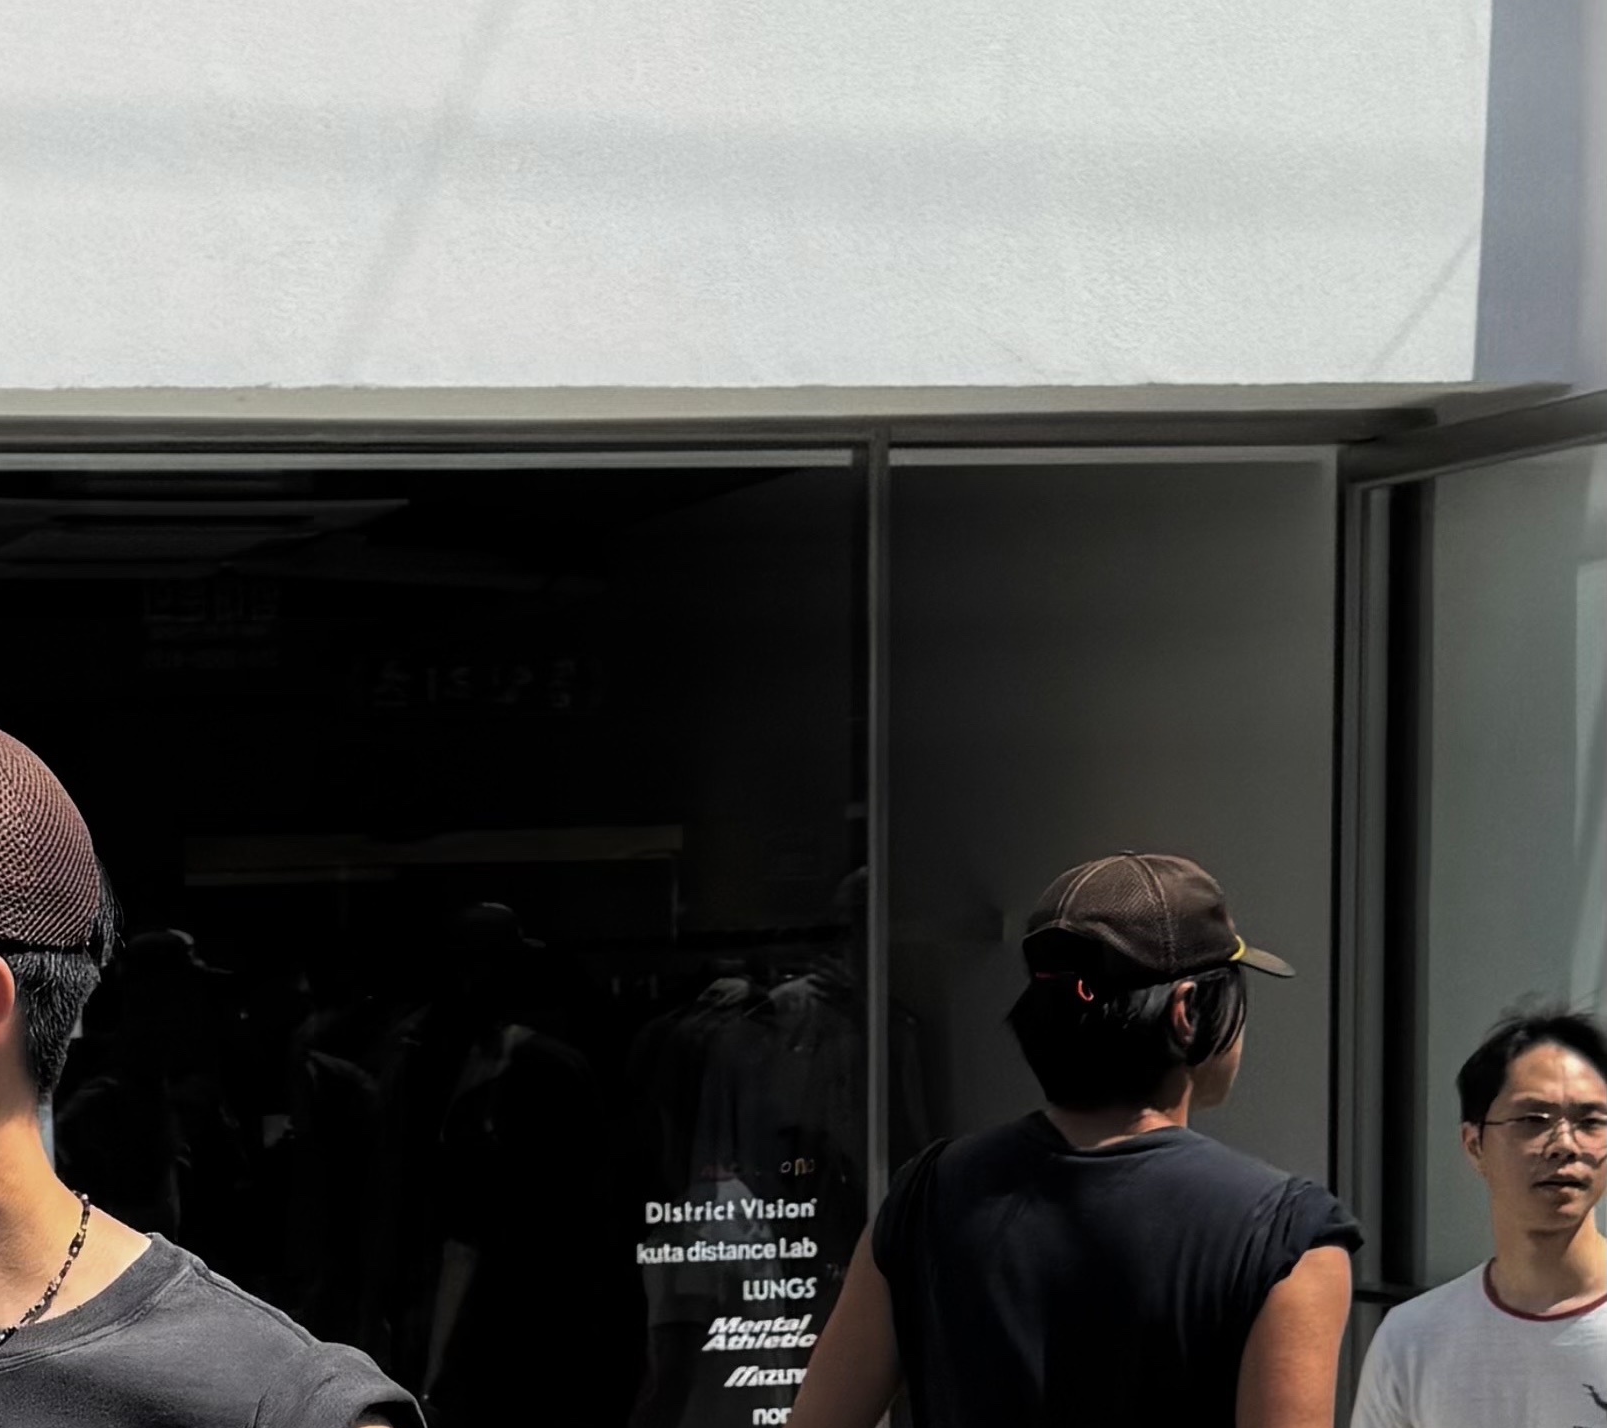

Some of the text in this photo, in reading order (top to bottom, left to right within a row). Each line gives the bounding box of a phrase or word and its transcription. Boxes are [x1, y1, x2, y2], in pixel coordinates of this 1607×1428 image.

[645, 1200, 735, 1224] District
[686, 1240, 777, 1262] distance
[742, 1276, 818, 1301] LUNGS
[707, 1313, 813, 1335] Mental
[701, 1331, 818, 1351] Athletic
[752, 1407, 792, 1426] nor
